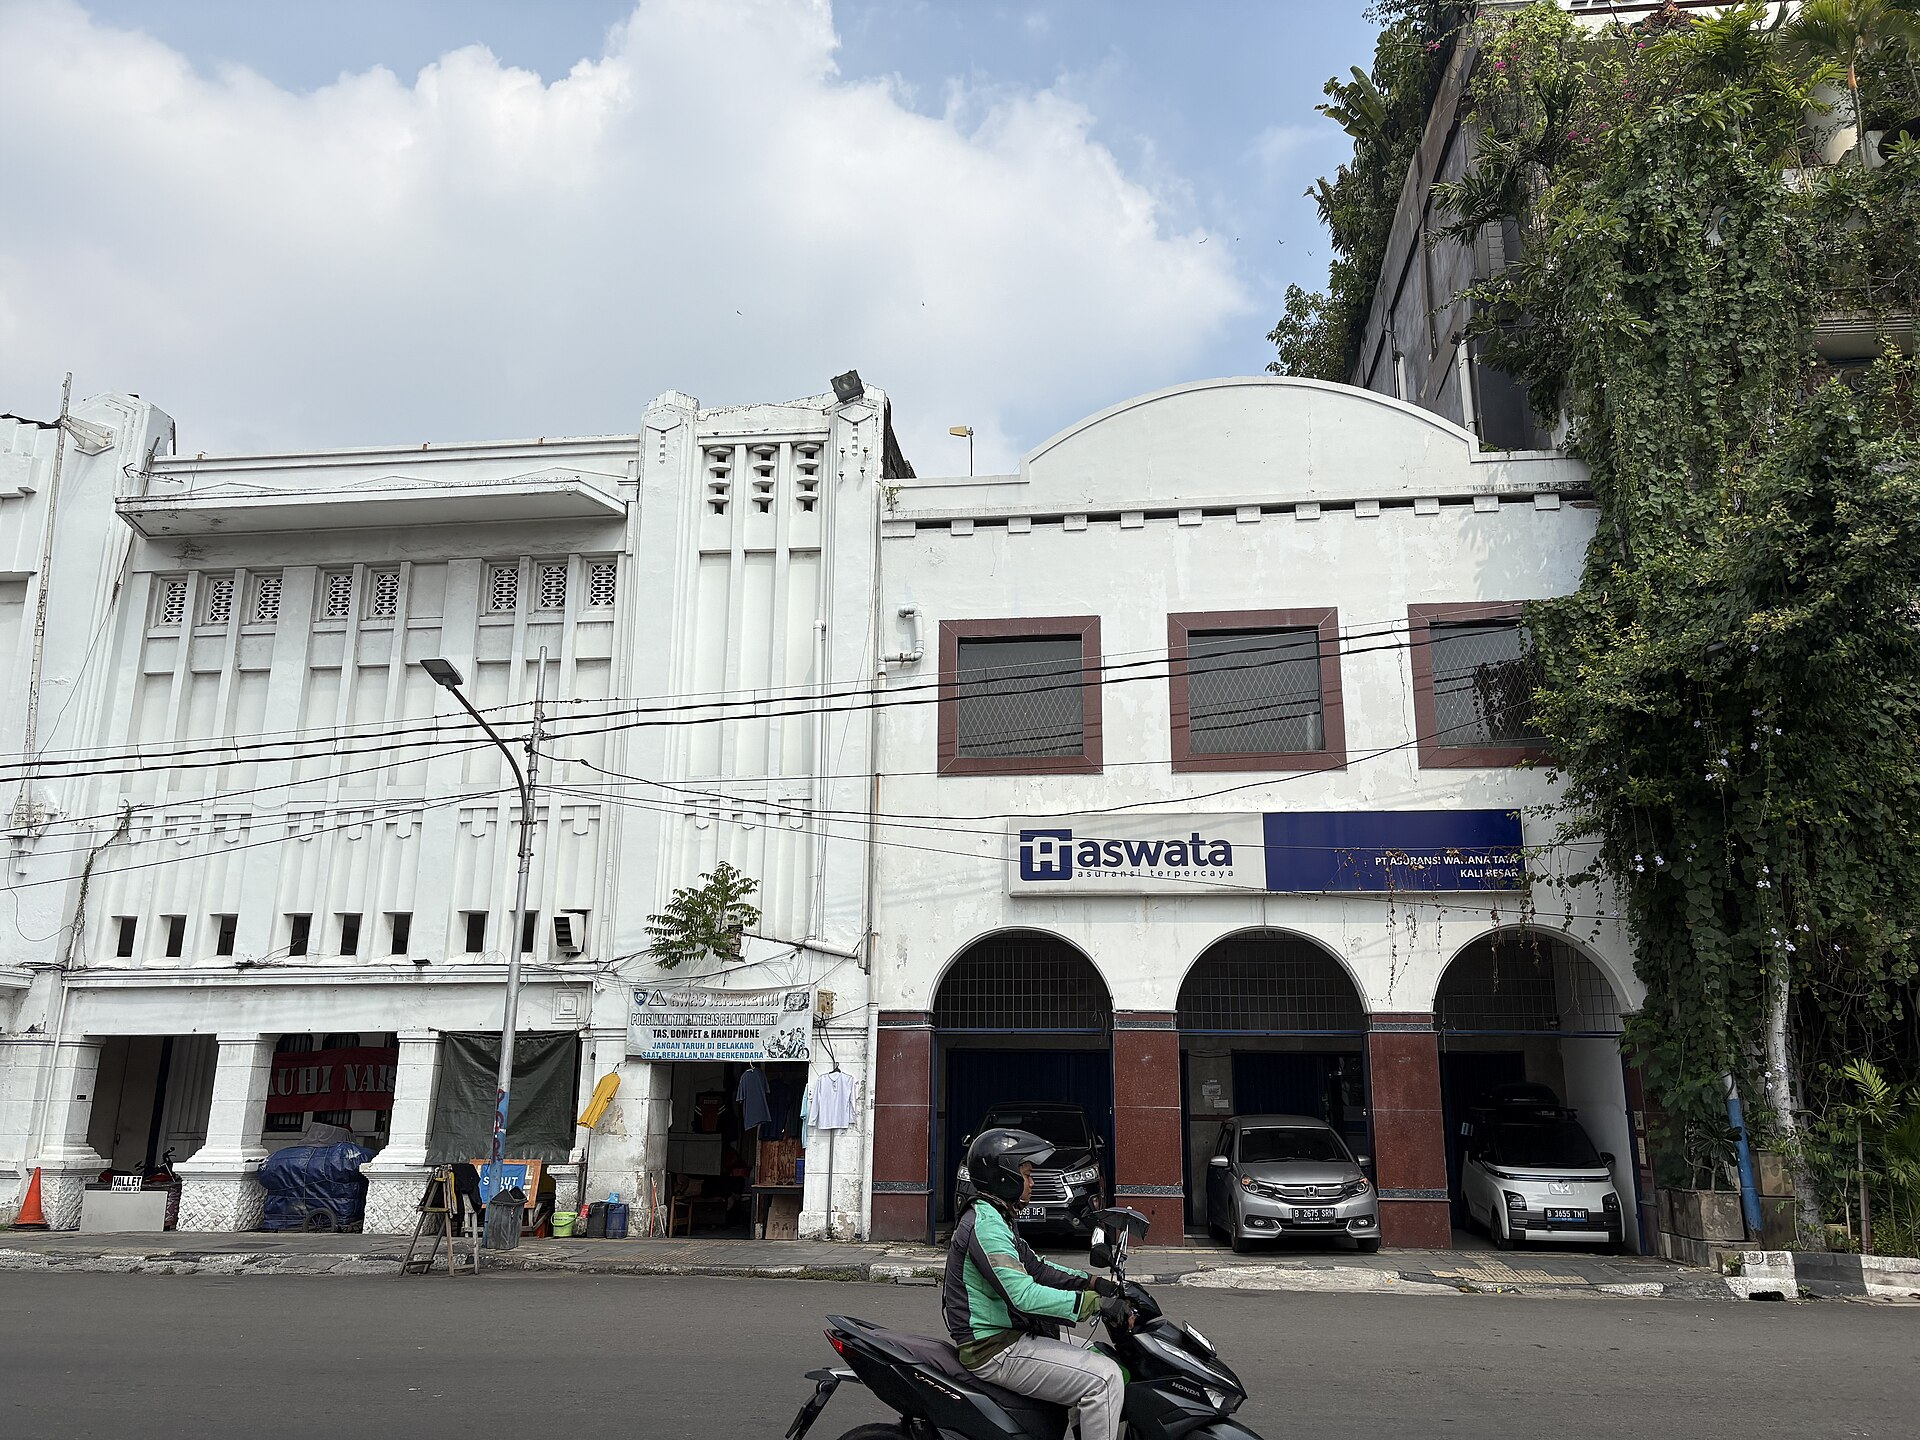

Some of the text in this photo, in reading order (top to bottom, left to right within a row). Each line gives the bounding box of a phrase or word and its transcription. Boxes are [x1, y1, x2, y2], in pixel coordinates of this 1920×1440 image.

[1077, 832, 1233, 867] aswata
[1375, 857, 1387, 866] PT
[1078, 869, 1234, 880] asuransi terpercaya
[1460, 869, 1483, 878] KALI
[699, 1013, 720, 1026] TEGAS
[720, 1013, 746, 1026] PELAKU
[746, 1013, 778, 1026] JAMBRET
[670, 1029, 702, 1039] DOMPET
[703, 1029, 710, 1039] &
[711, 1029, 760, 1039] HANDPHONE
[652, 1042, 754, 1050] JANGAN TARUH DI BELAKANG
[641, 1052, 764, 1060] SAAT BERJALAN DAN BERKENDARA
[113, 1176, 142, 1187] VALLET
[1294, 1210, 1299, 1218] B
[1303, 1209, 1319, 1218] 2675
[1171, 1381, 1201, 1397] HONDA
